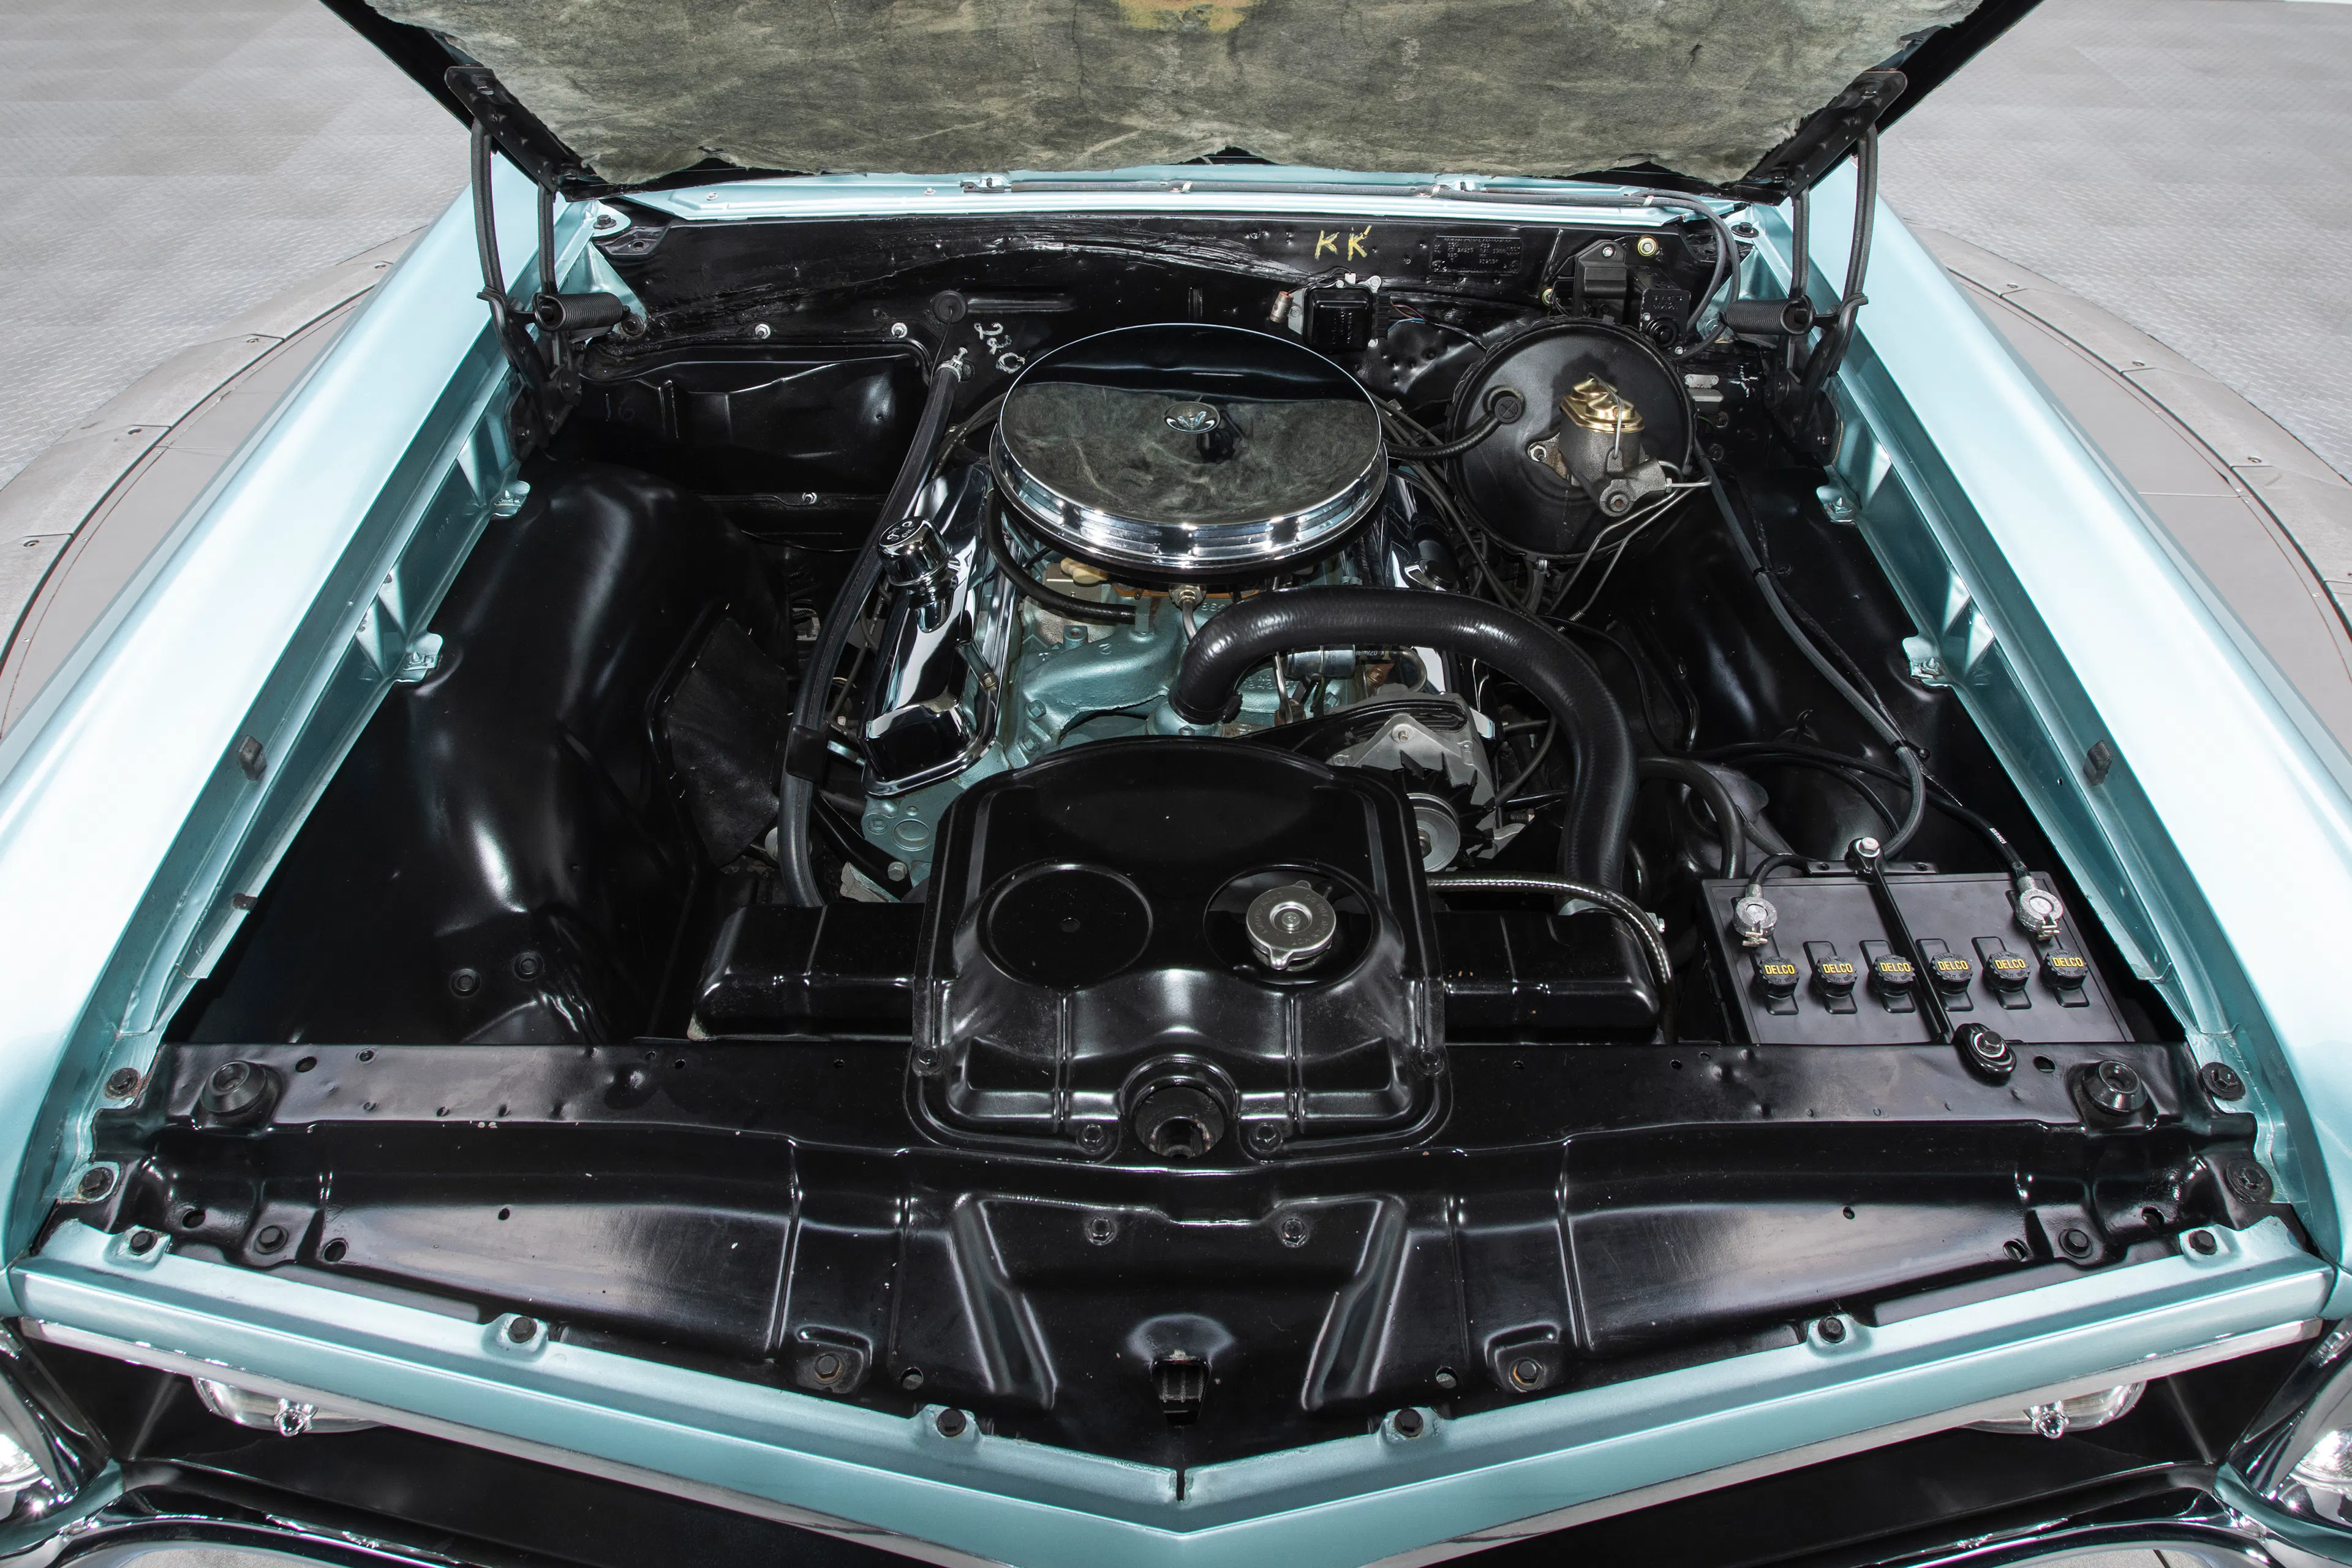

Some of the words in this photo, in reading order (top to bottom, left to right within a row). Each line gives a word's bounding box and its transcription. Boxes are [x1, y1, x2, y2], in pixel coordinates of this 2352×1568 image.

[1937, 960, 1969, 970] DELCO
[1994, 959, 2027, 970] DELCO
[2051, 957, 2084, 967] DELCO
[1764, 964, 1795, 974] DELCO
[1822, 963, 1854, 973] DELCO
[1880, 962, 1912, 973] DELCO
